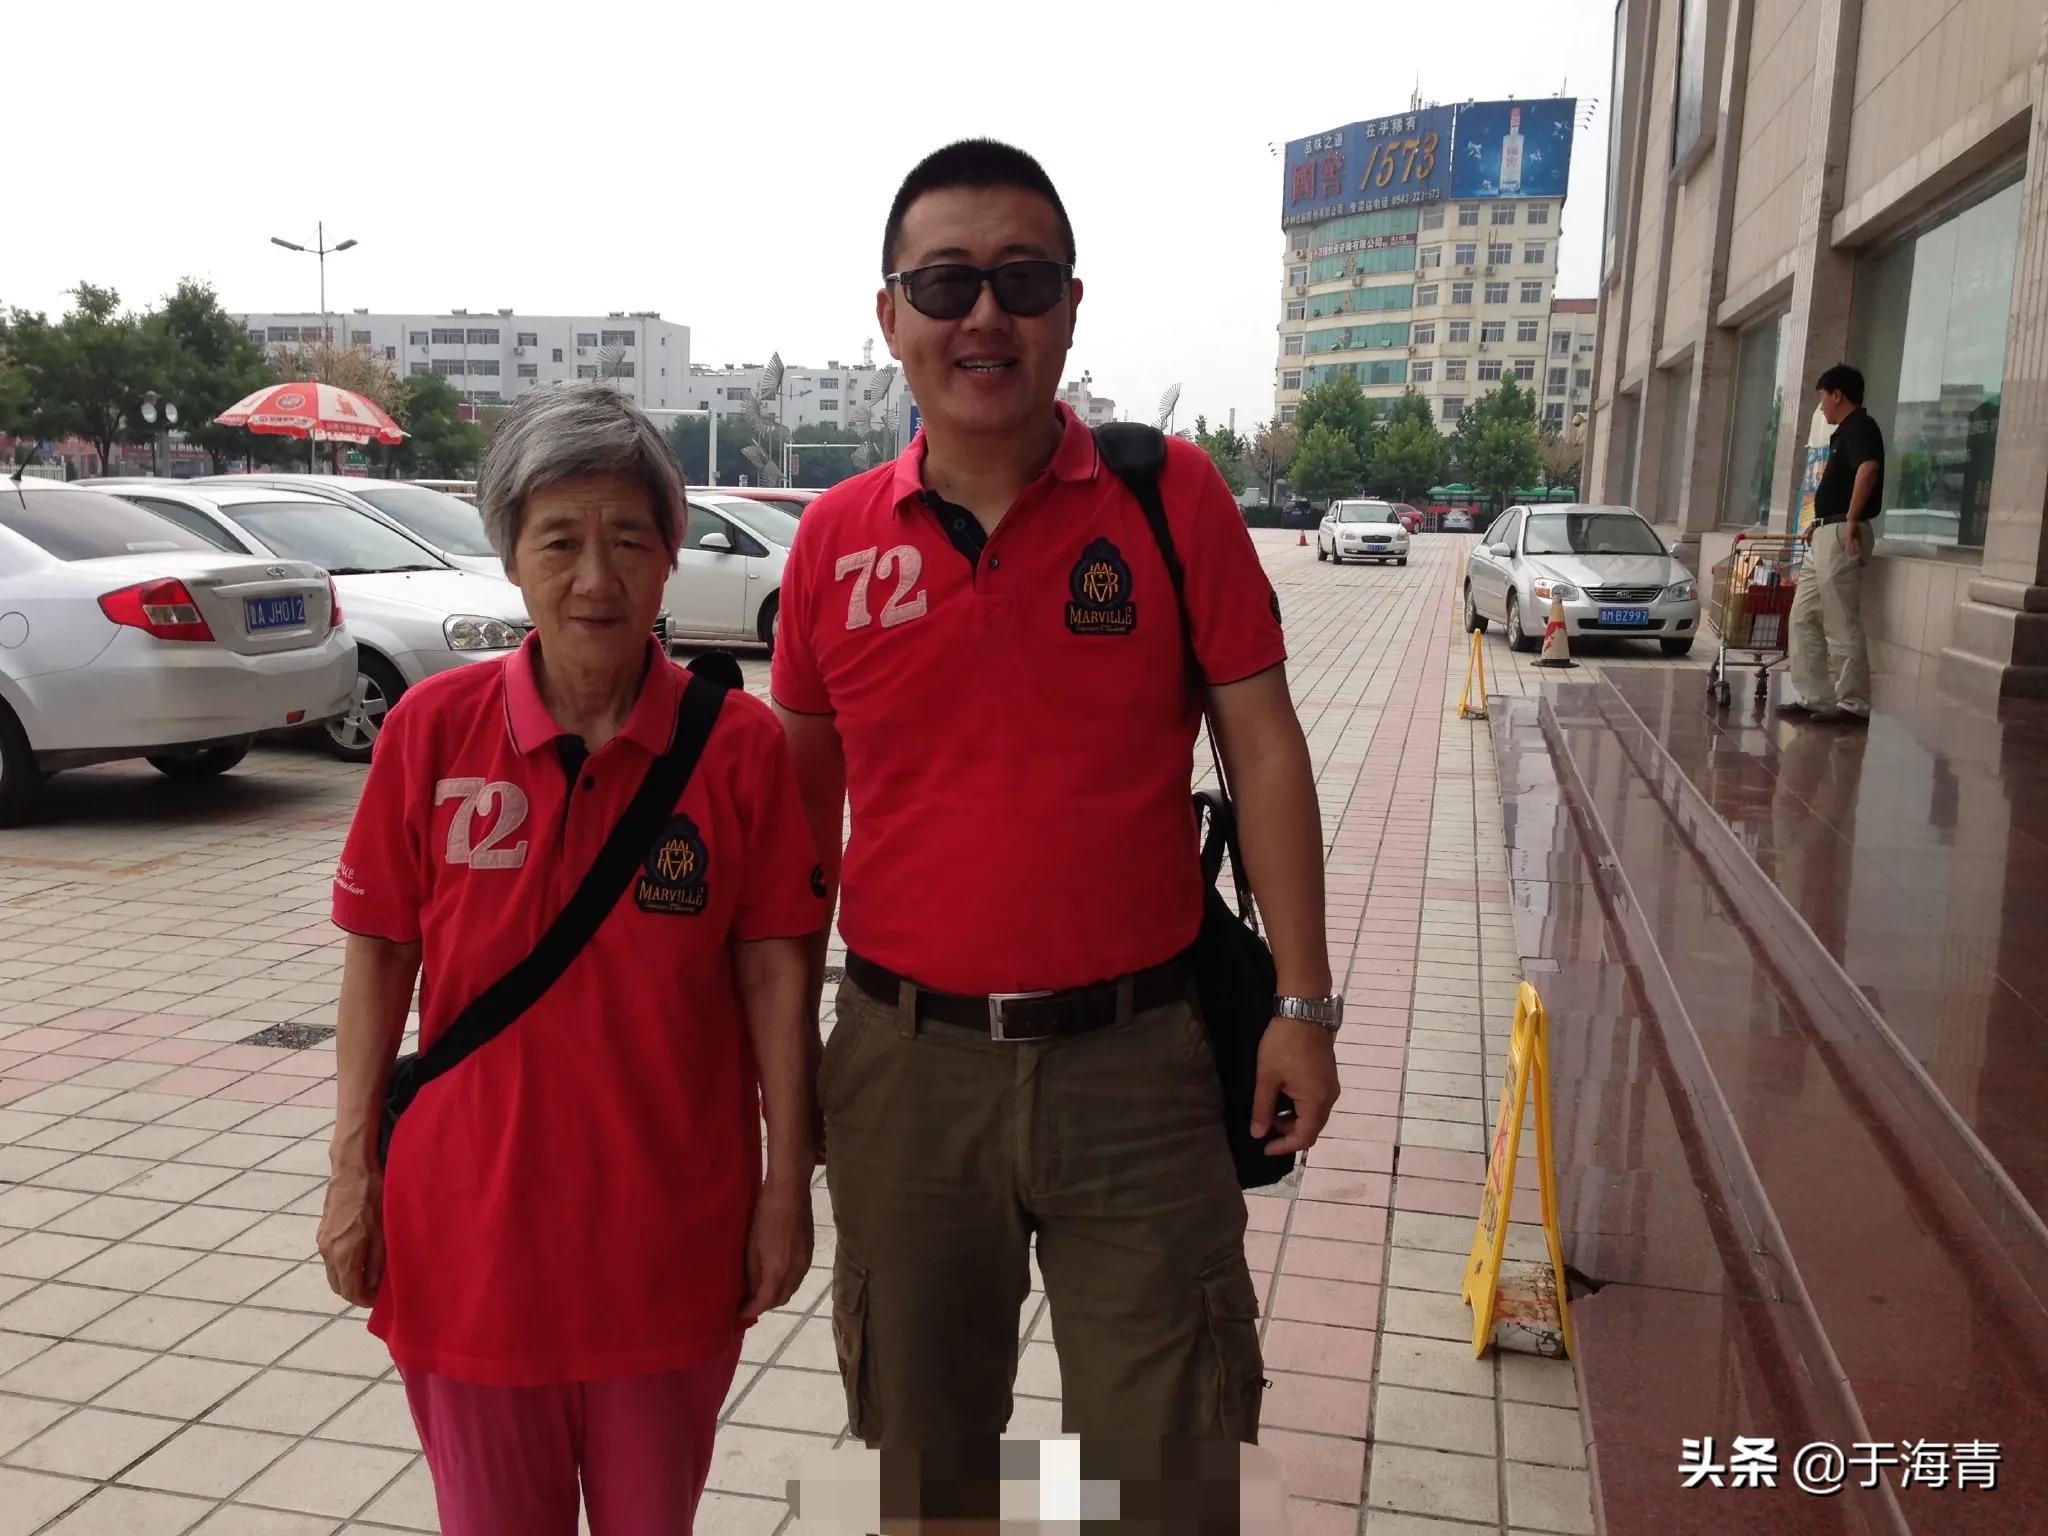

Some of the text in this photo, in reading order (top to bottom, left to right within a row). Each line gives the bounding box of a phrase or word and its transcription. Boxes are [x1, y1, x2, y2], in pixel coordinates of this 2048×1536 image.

[1359, 132, 1440, 191] 1573
[835, 544, 928, 630] 72
[1070, 605, 1132, 625] MARVILLE
[435, 777, 529, 869] 72
[639, 880, 705, 906] MARVILLE
